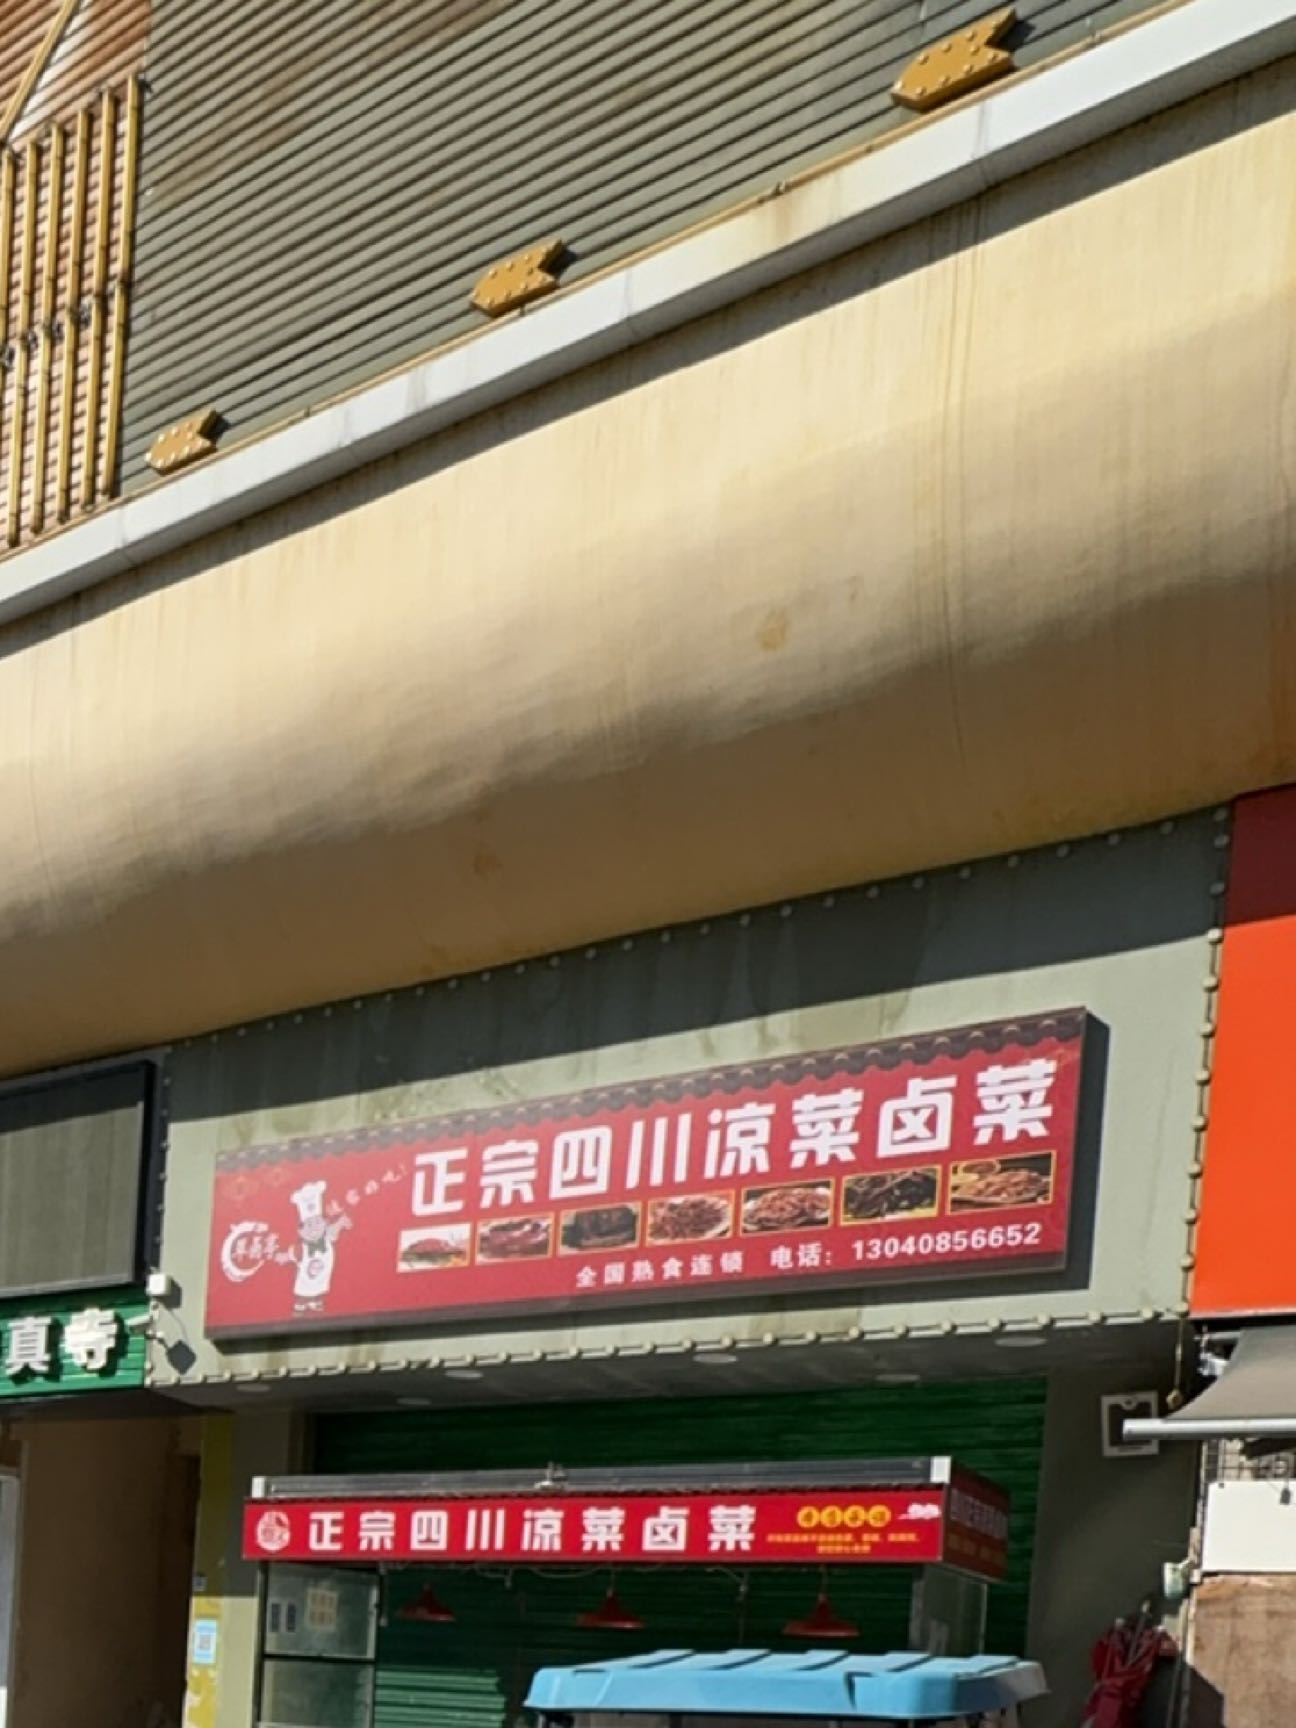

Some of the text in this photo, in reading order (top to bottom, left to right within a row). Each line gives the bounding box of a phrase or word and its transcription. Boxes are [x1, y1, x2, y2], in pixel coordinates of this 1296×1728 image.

[409, 1058, 1058, 1216] 正宗四川凉菜卤菜
[575, 1249, 744, 1288] 全国熟食连锁
[851, 1222, 1043, 1261] 13040856652
[307, 1503, 757, 1553] 正宗四川凉菜卤菜
